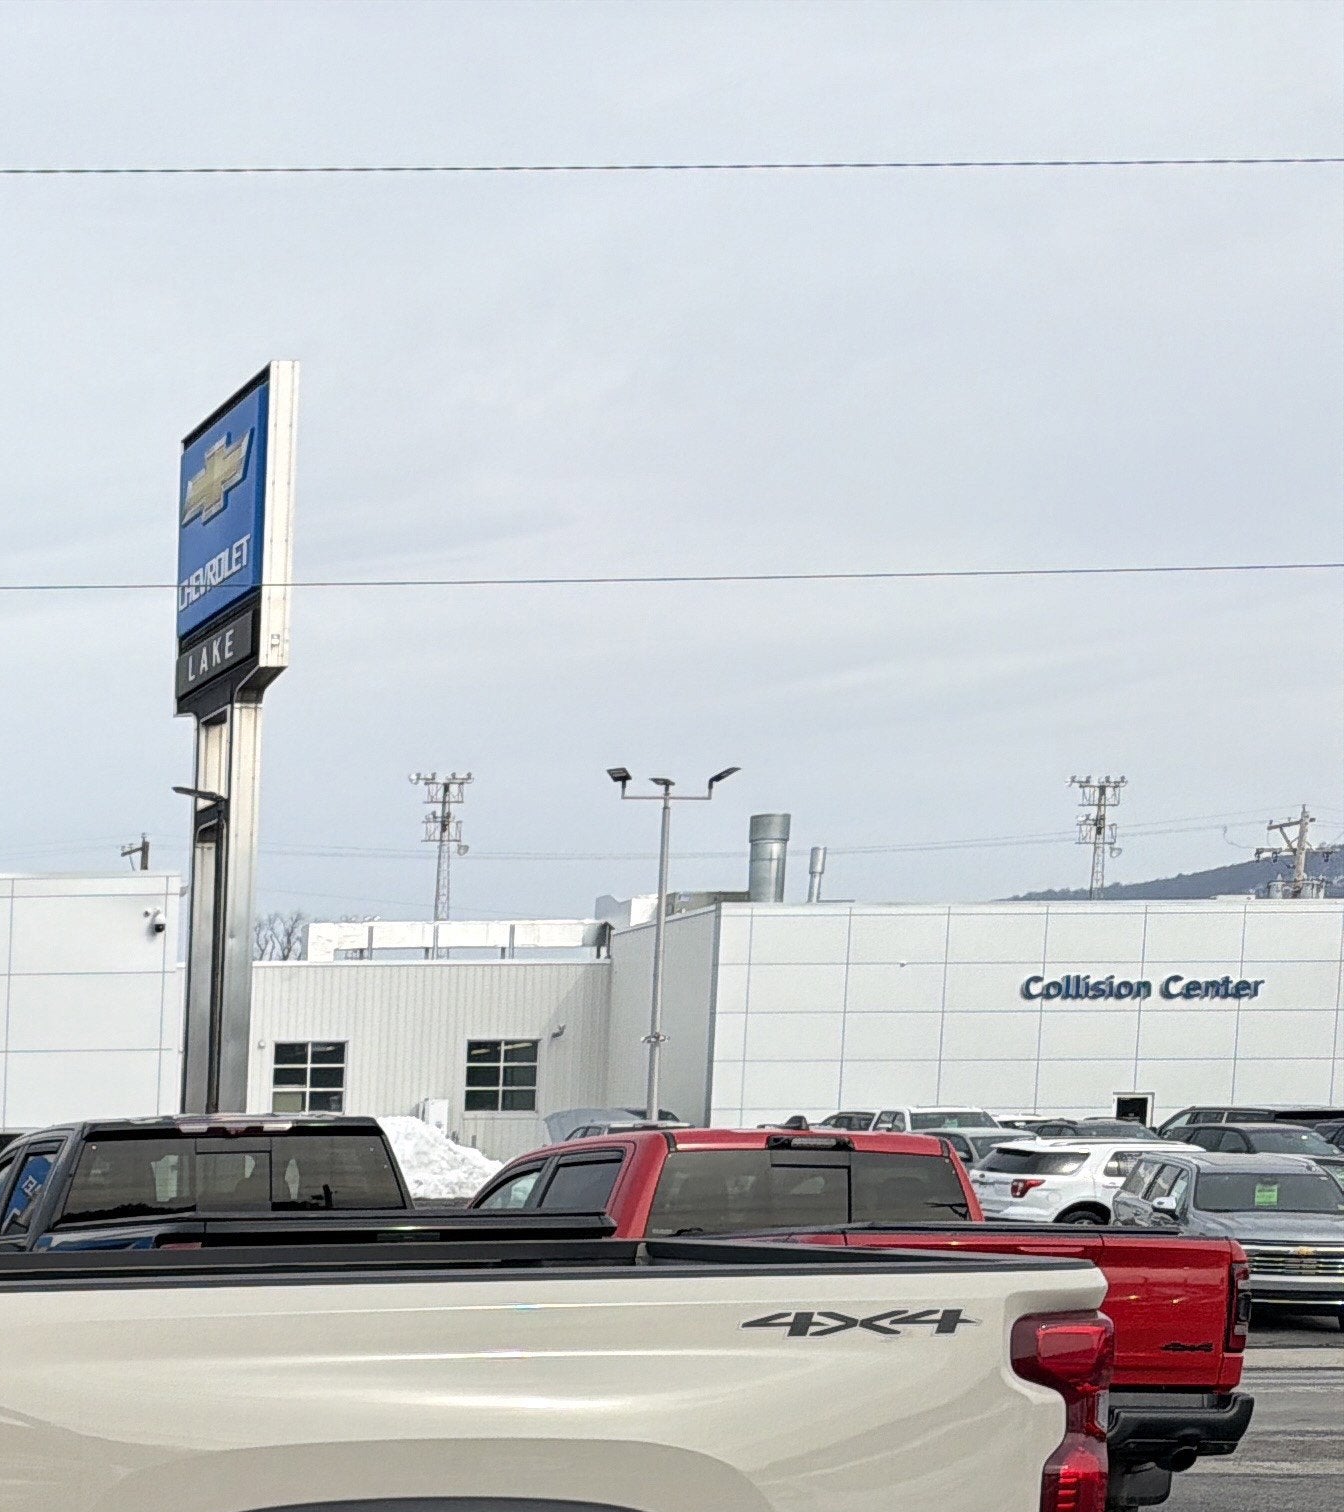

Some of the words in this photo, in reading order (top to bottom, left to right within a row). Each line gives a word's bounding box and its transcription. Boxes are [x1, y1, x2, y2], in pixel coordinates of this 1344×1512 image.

[178, 533, 251, 612] CHEVROLET
[188, 628, 235, 682] LAKE
[1020, 974, 1153, 1001] Collision
[1159, 974, 1266, 1001] Center
